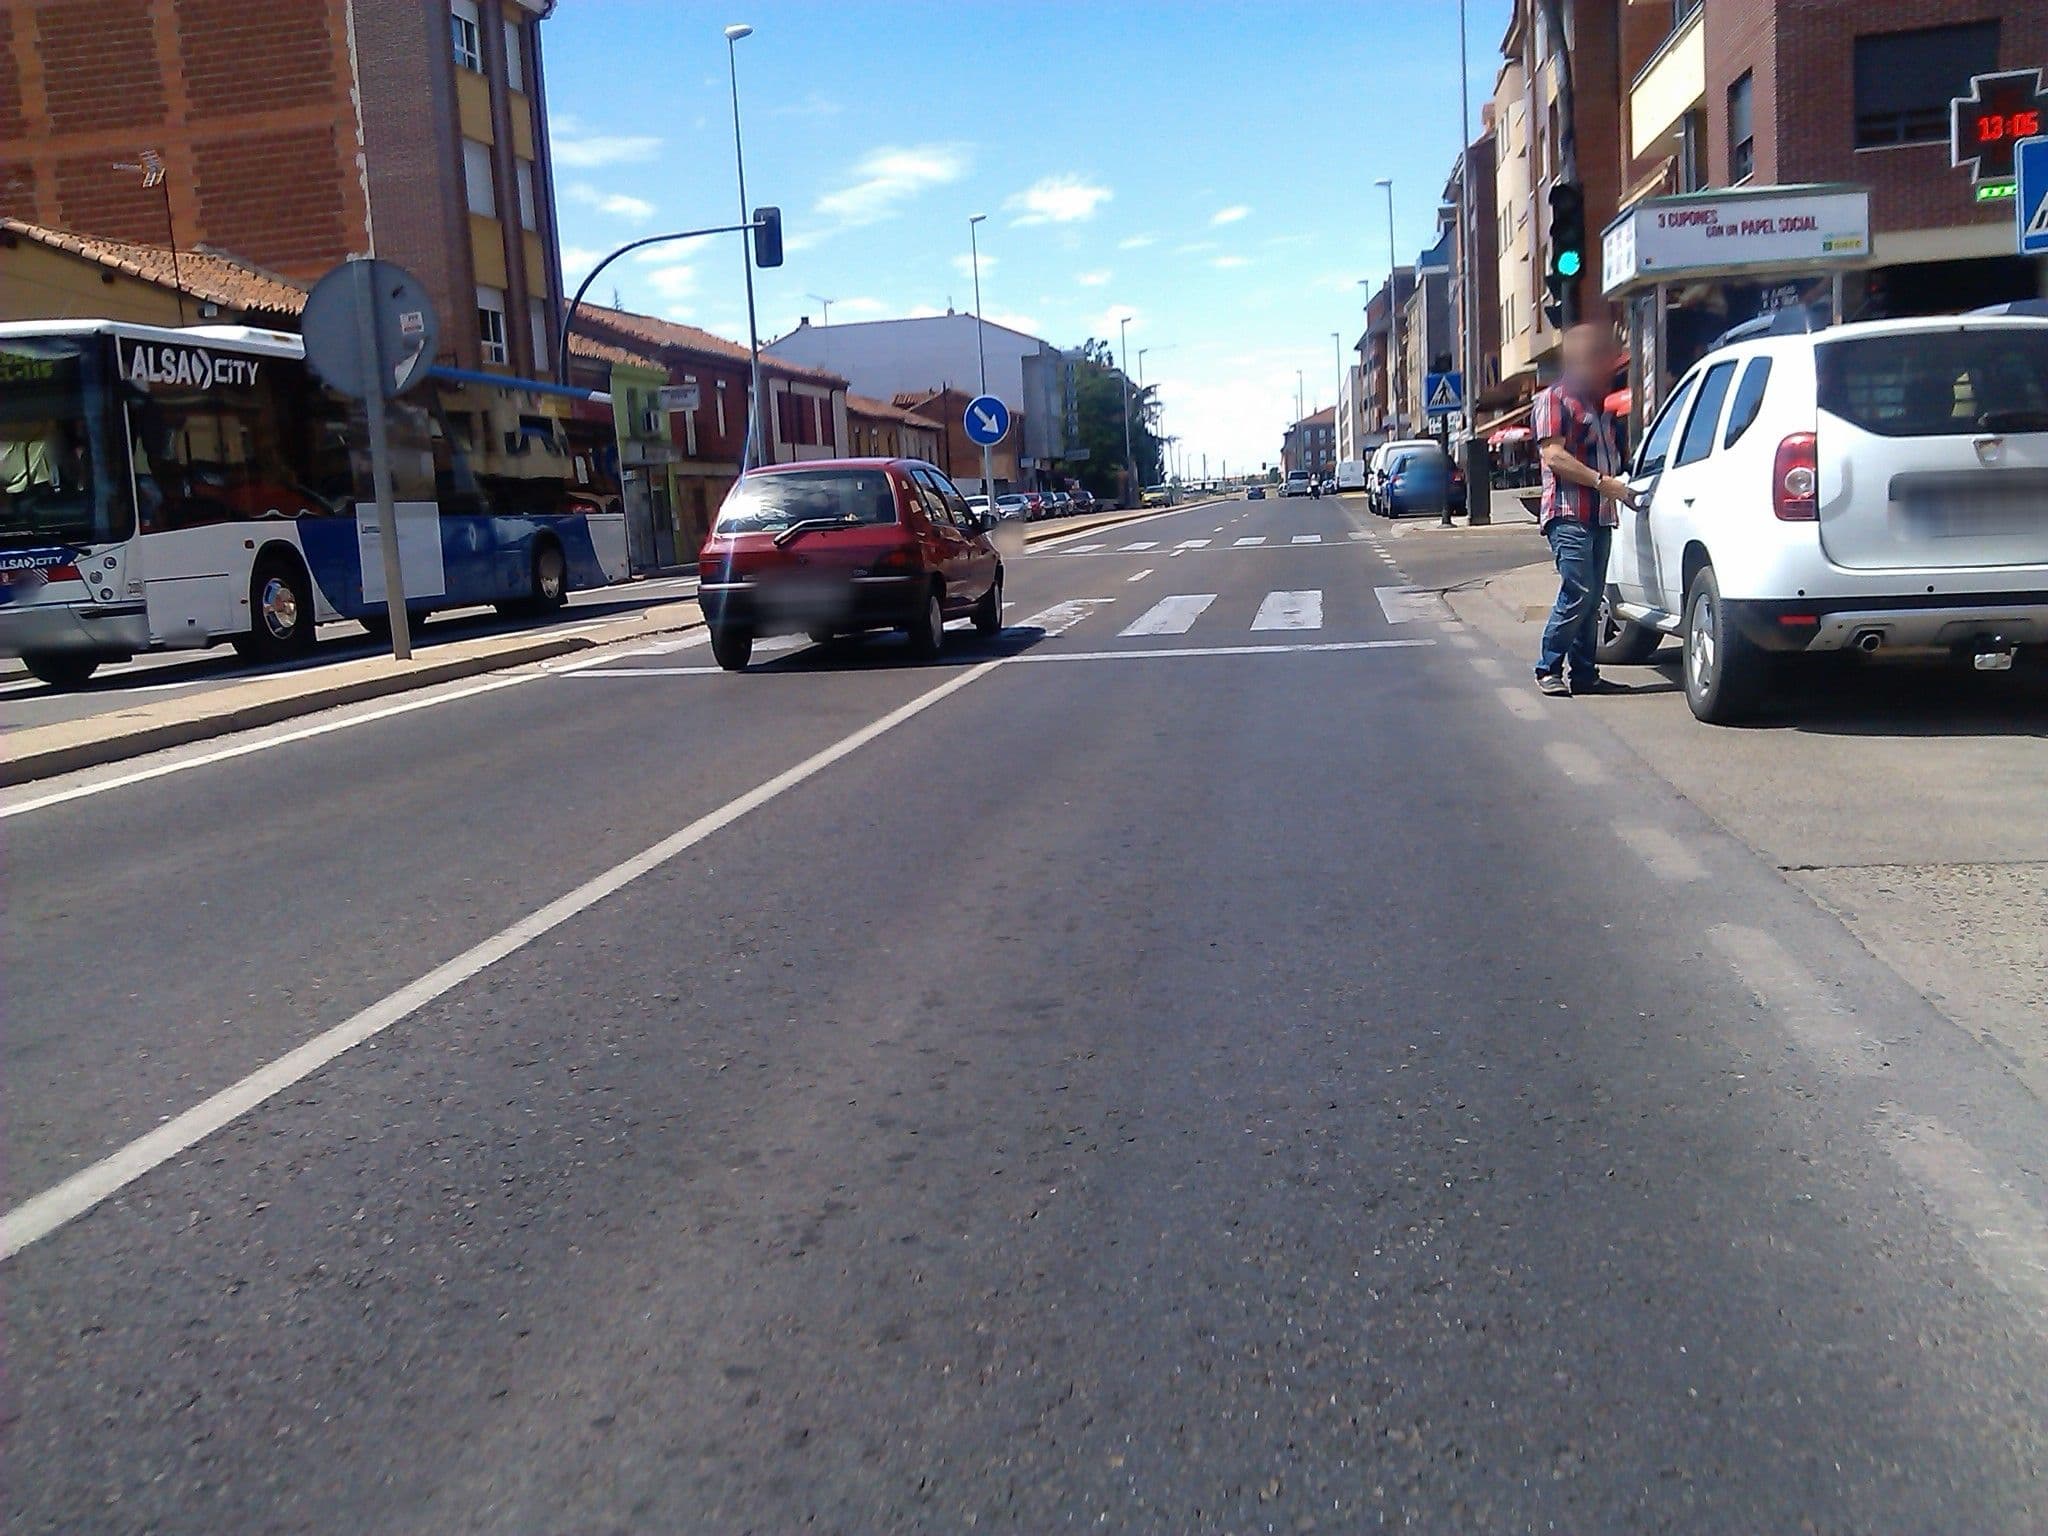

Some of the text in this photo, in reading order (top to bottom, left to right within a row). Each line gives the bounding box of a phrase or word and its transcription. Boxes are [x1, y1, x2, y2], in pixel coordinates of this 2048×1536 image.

[1658, 210, 1719, 228] 3 CUPONES
[1741, 219, 1776, 235] PAPEL
[1778, 216, 1818, 233] SOCIAL
[131, 345, 193, 385] ALSA
[0, 558, 25, 570] LSA
